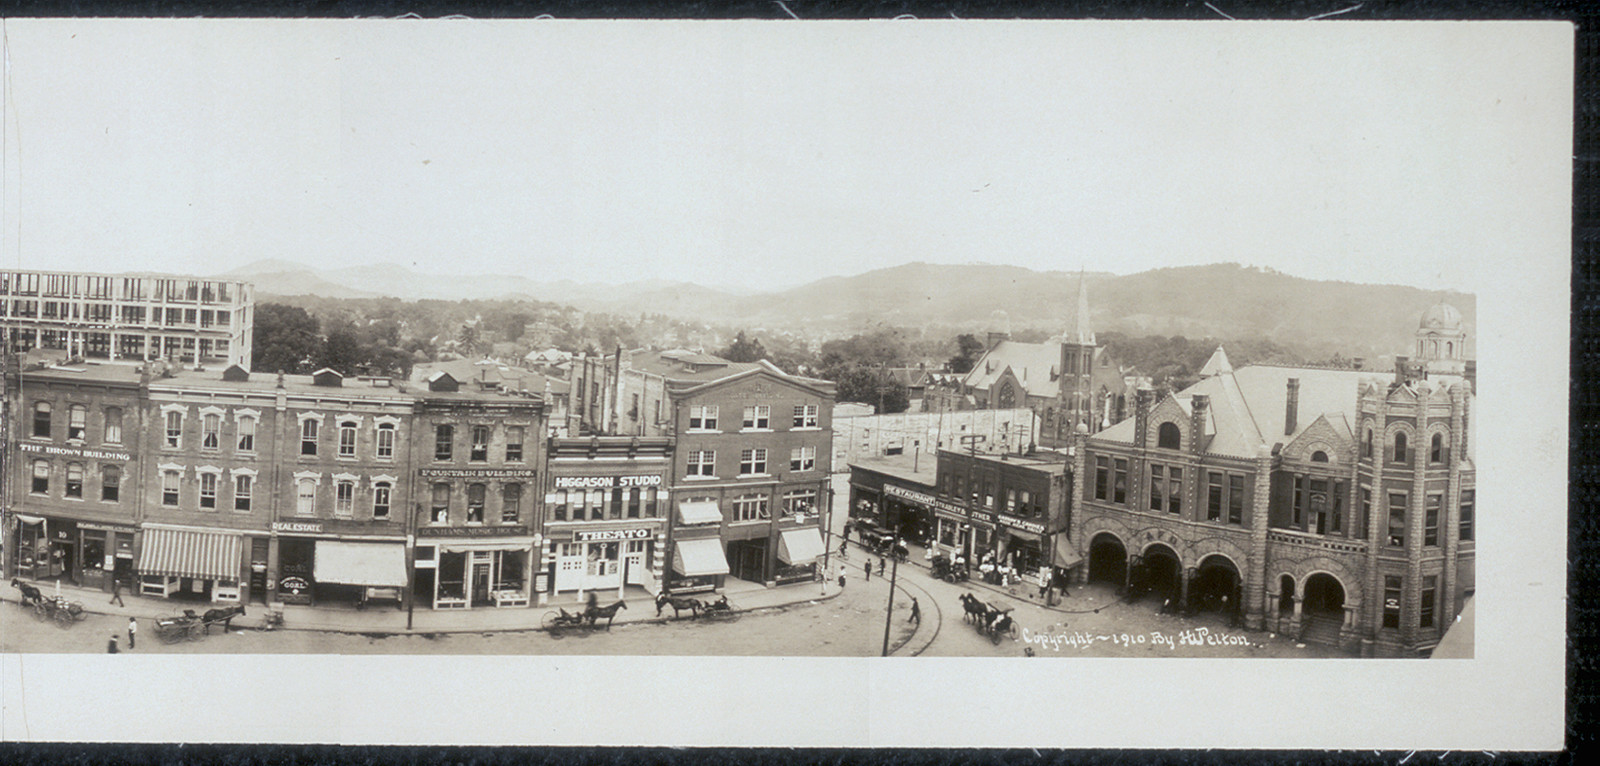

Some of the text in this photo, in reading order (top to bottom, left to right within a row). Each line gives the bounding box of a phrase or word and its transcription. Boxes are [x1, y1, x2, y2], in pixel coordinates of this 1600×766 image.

[20, 443, 130, 461] THE BROWN BUILDING
[556, 475, 661, 487] HIGGASON STUDIO
[886, 484, 933, 505] RESTAURANT
[272, 522, 320, 532] REAL ESTATE
[579, 529, 648, 540] THEATO
